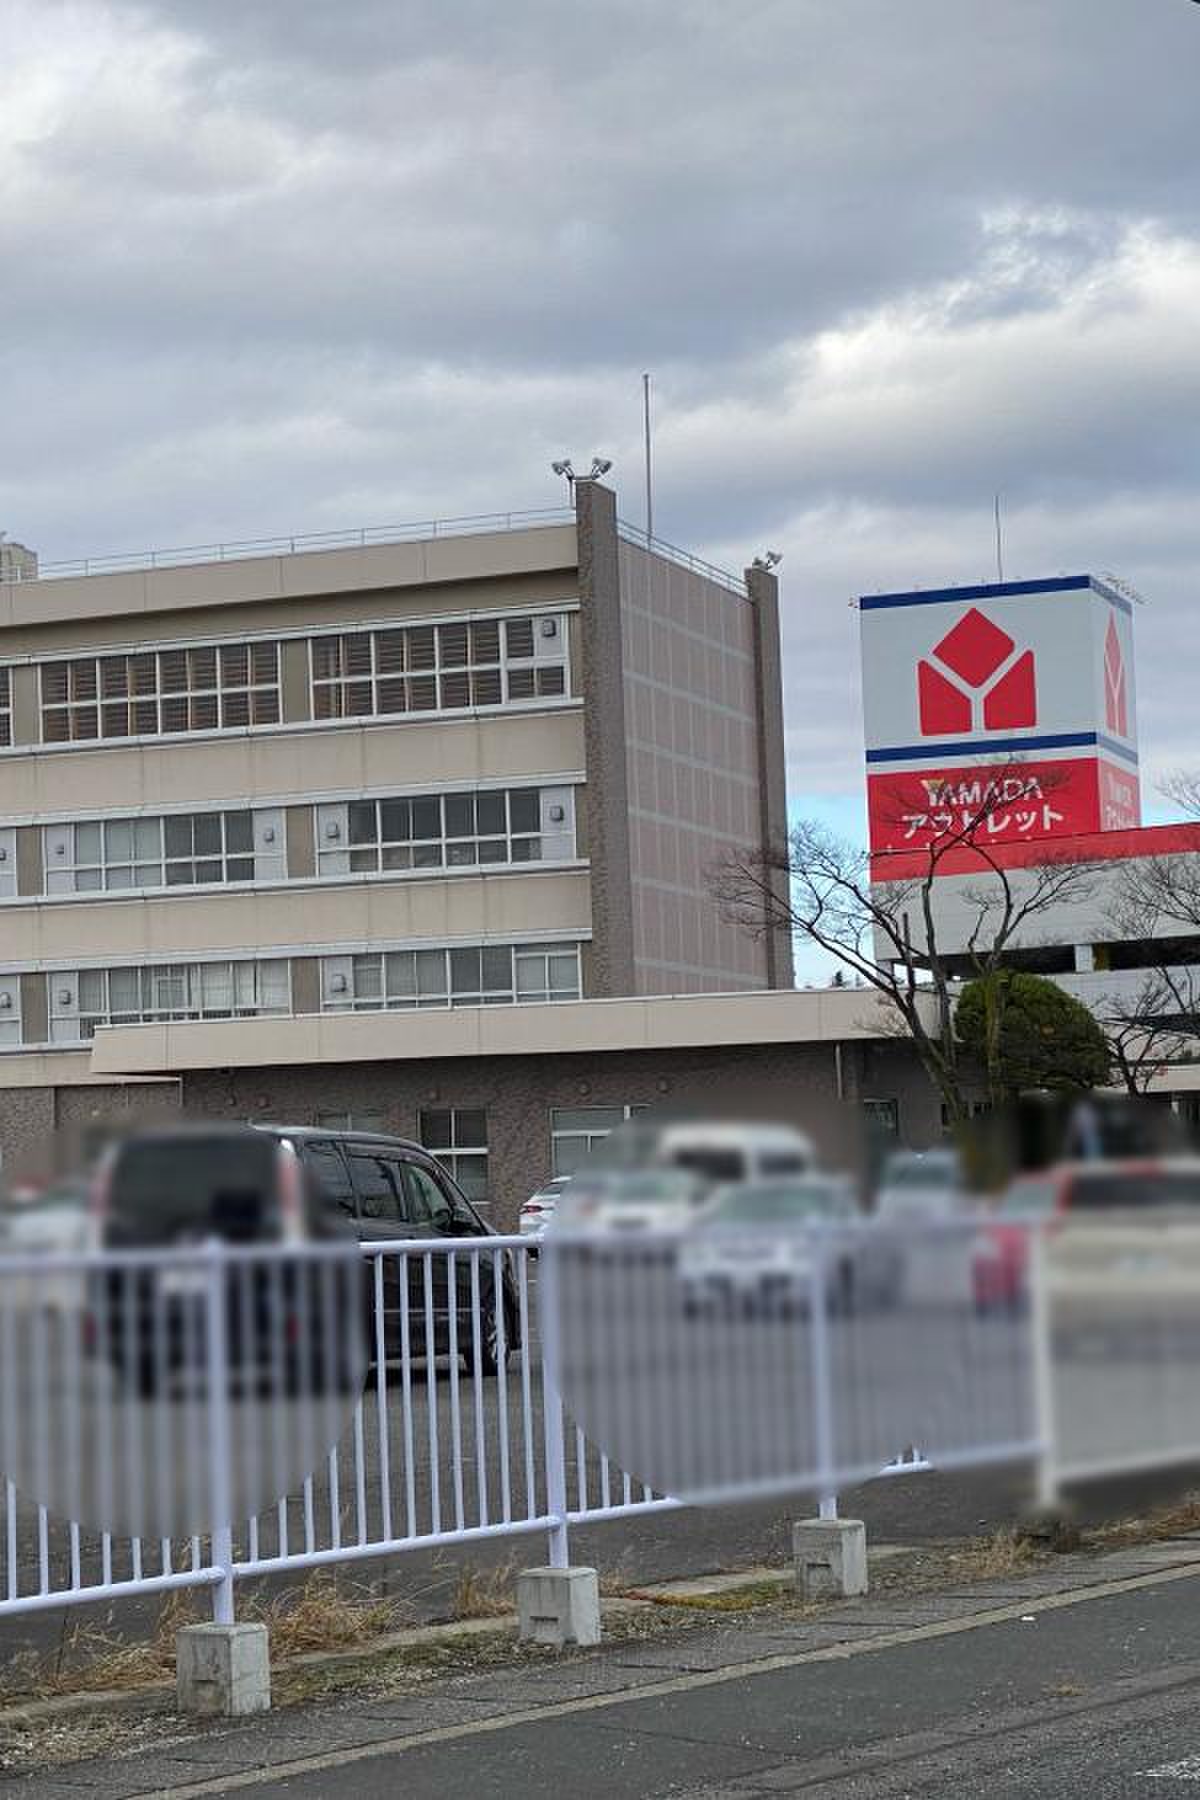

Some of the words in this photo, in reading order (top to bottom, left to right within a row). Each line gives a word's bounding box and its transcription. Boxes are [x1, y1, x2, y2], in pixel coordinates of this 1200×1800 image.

[920, 776, 1044, 807] YAMADA
[901, 803, 1064, 839] アウトレット
